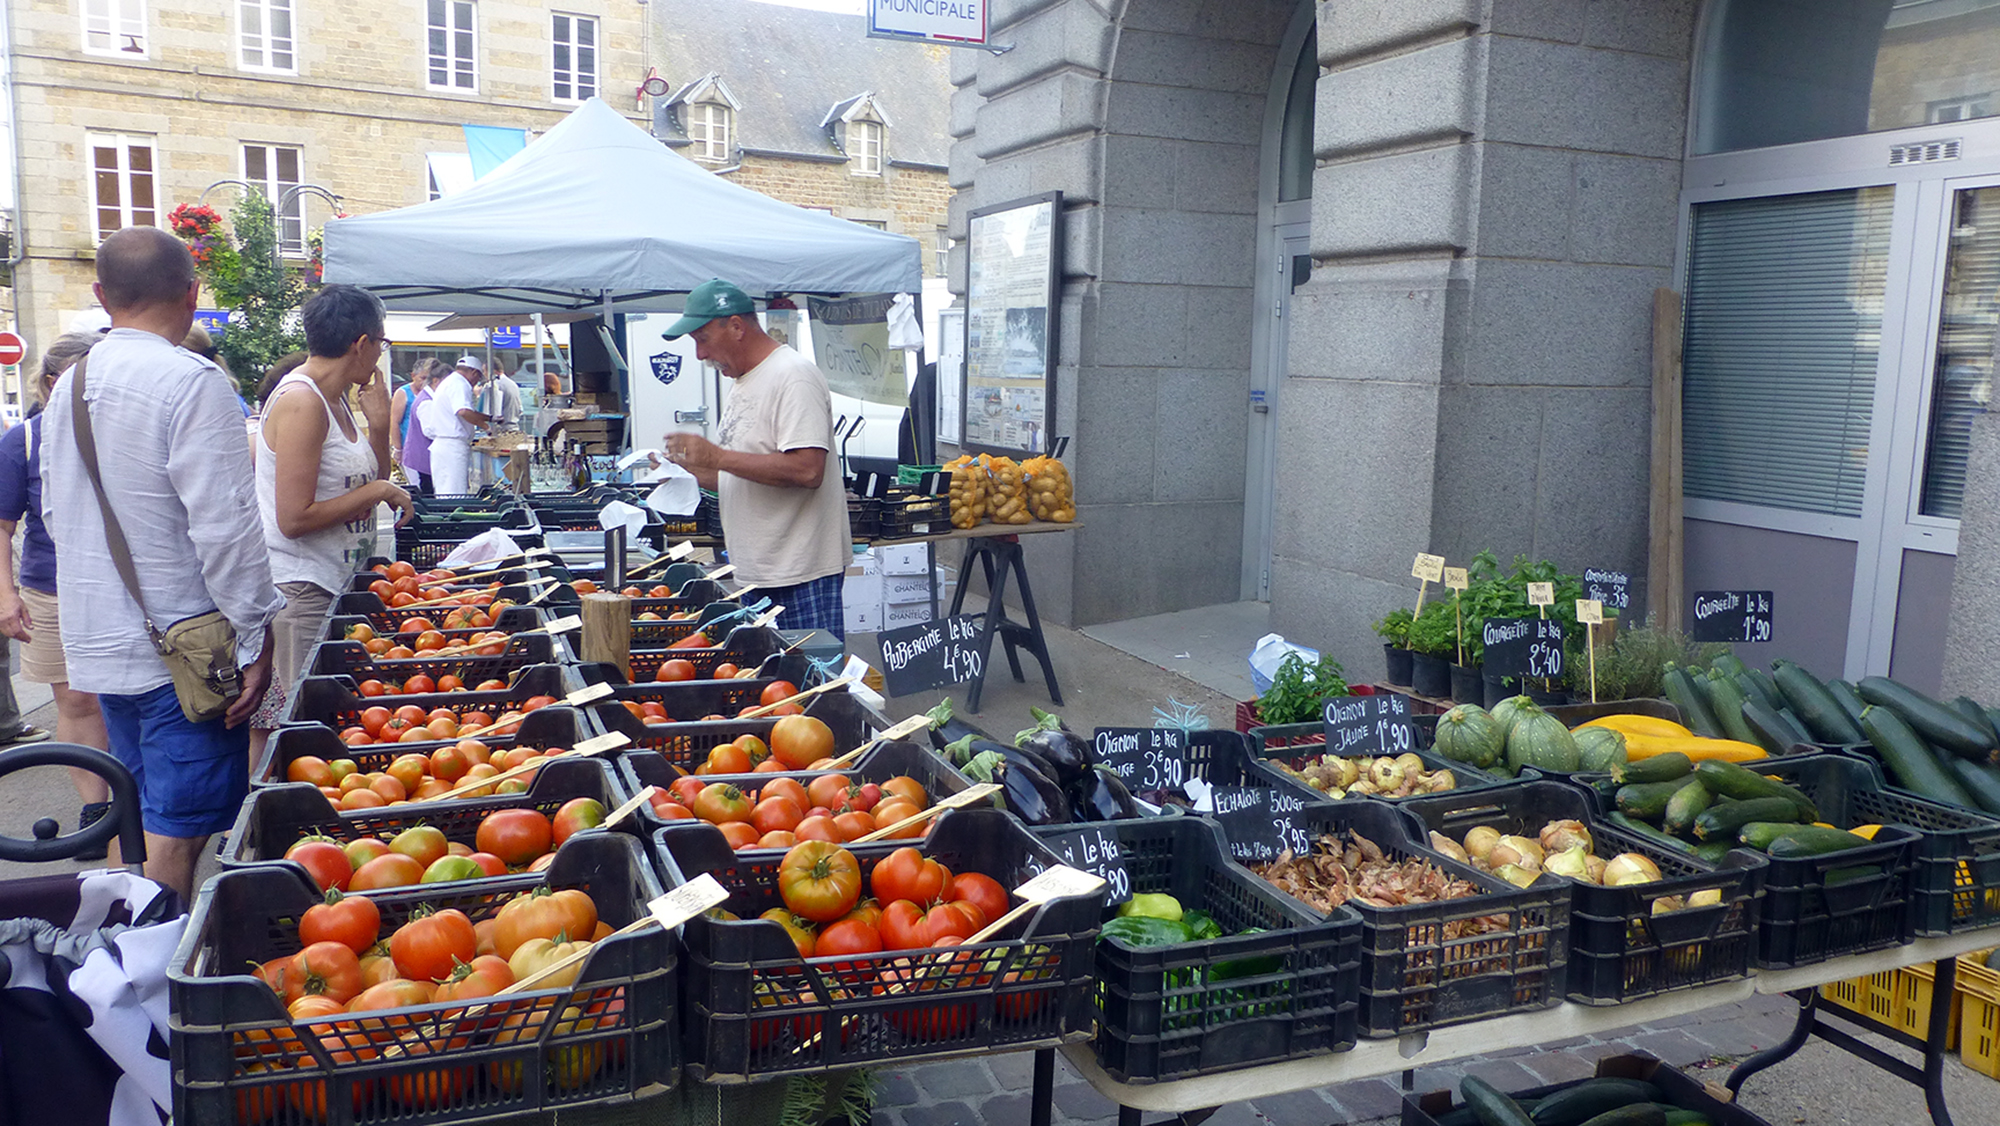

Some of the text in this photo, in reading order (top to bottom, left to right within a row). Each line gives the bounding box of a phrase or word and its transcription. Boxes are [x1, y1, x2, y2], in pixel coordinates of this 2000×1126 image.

[880, 0, 976, 20] MUNICIPALE
[883, 625, 943, 672] AUBERGINE
[1334, 725, 1369, 751] JAUNE
[1215, 787, 1262, 815] ECHALOTE
